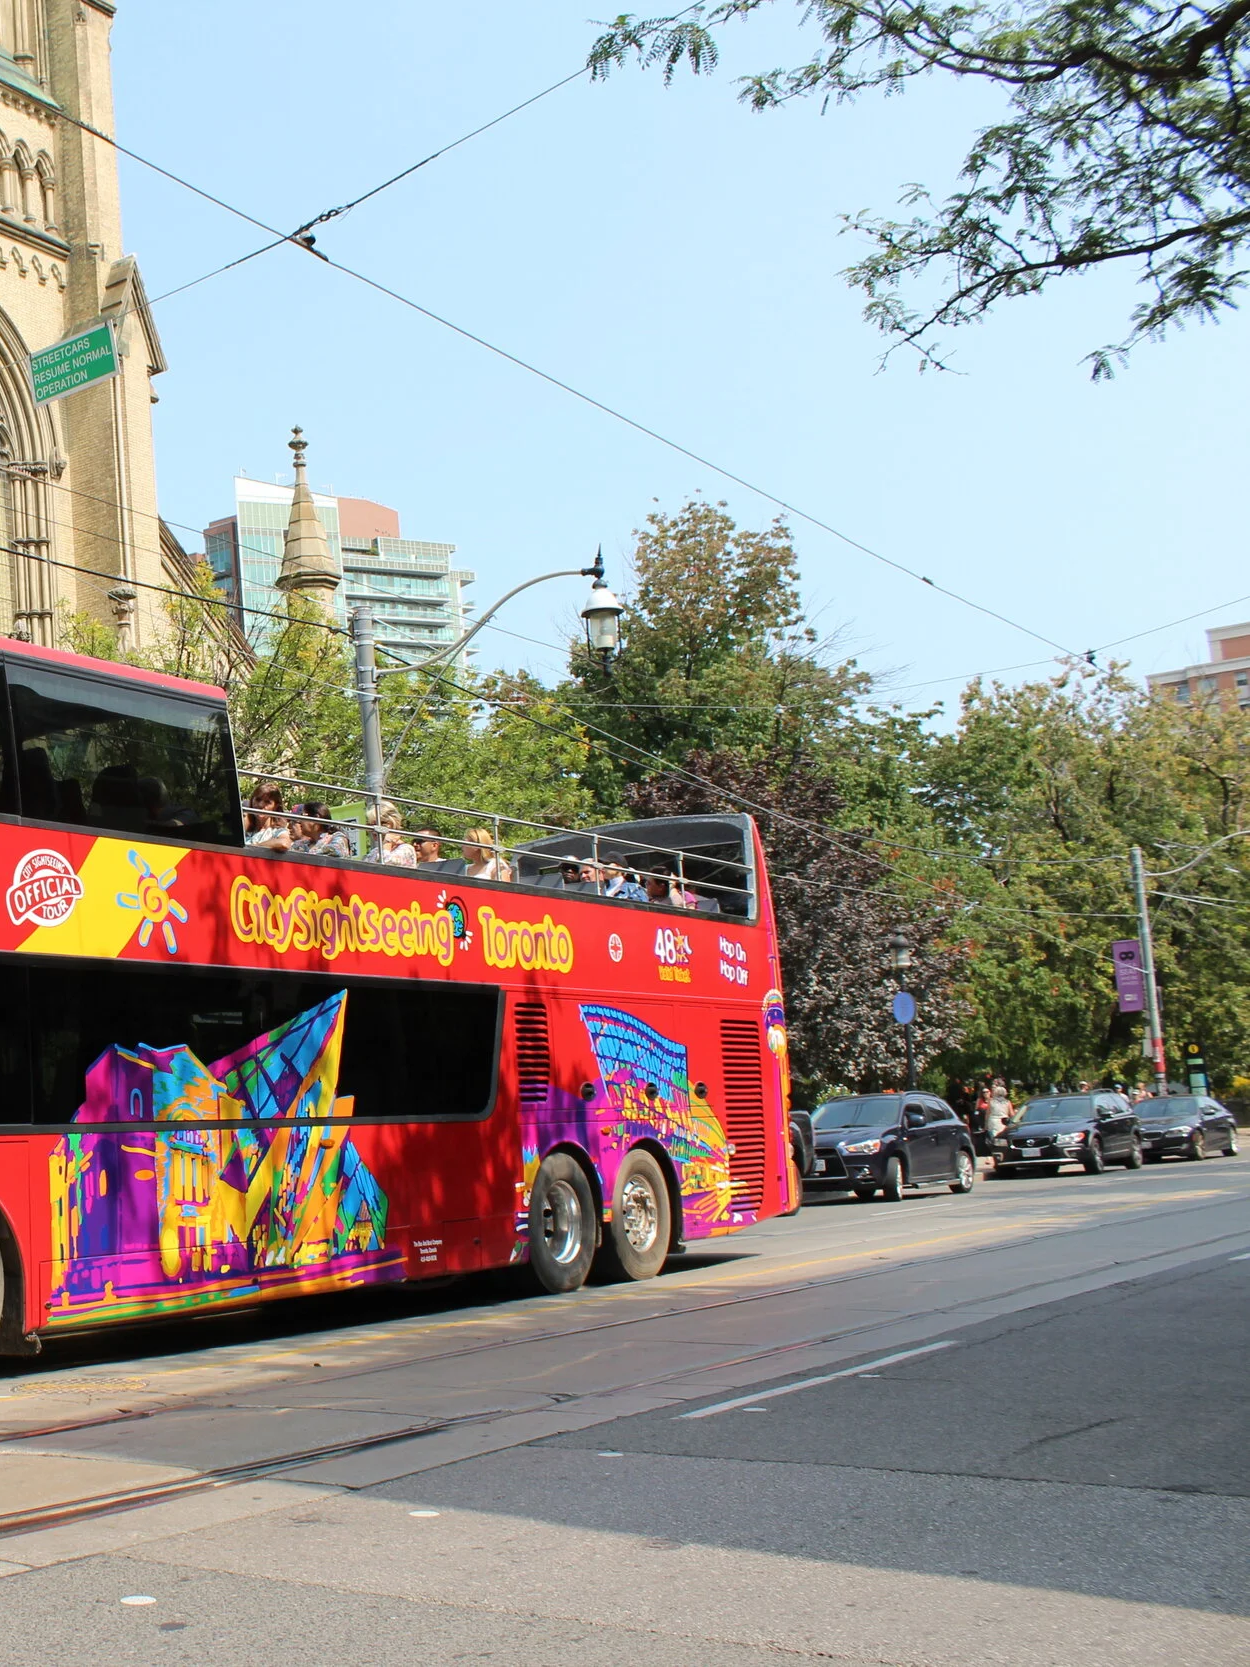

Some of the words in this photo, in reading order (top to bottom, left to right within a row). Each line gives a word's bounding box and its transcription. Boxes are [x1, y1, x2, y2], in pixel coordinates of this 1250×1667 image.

[32, 337, 90, 371] STREETCARS
[34, 361, 71, 385] RESUME
[72, 345, 111, 369] NORMAL
[36, 370, 88, 399] OPERATION
[22, 862, 33, 880] CITY
[32, 855, 66, 873] SIGHTSEEING
[14, 877, 80, 913] OFFICIAL
[41, 899, 69, 919] TOUR
[477, 905, 574, 974] Toronto
[654, 928, 677, 964] 48
[719, 935, 735, 959] Hop
[735, 942, 747, 963] On
[719, 959, 736, 982] Hop
[736, 965, 749, 986] Off
